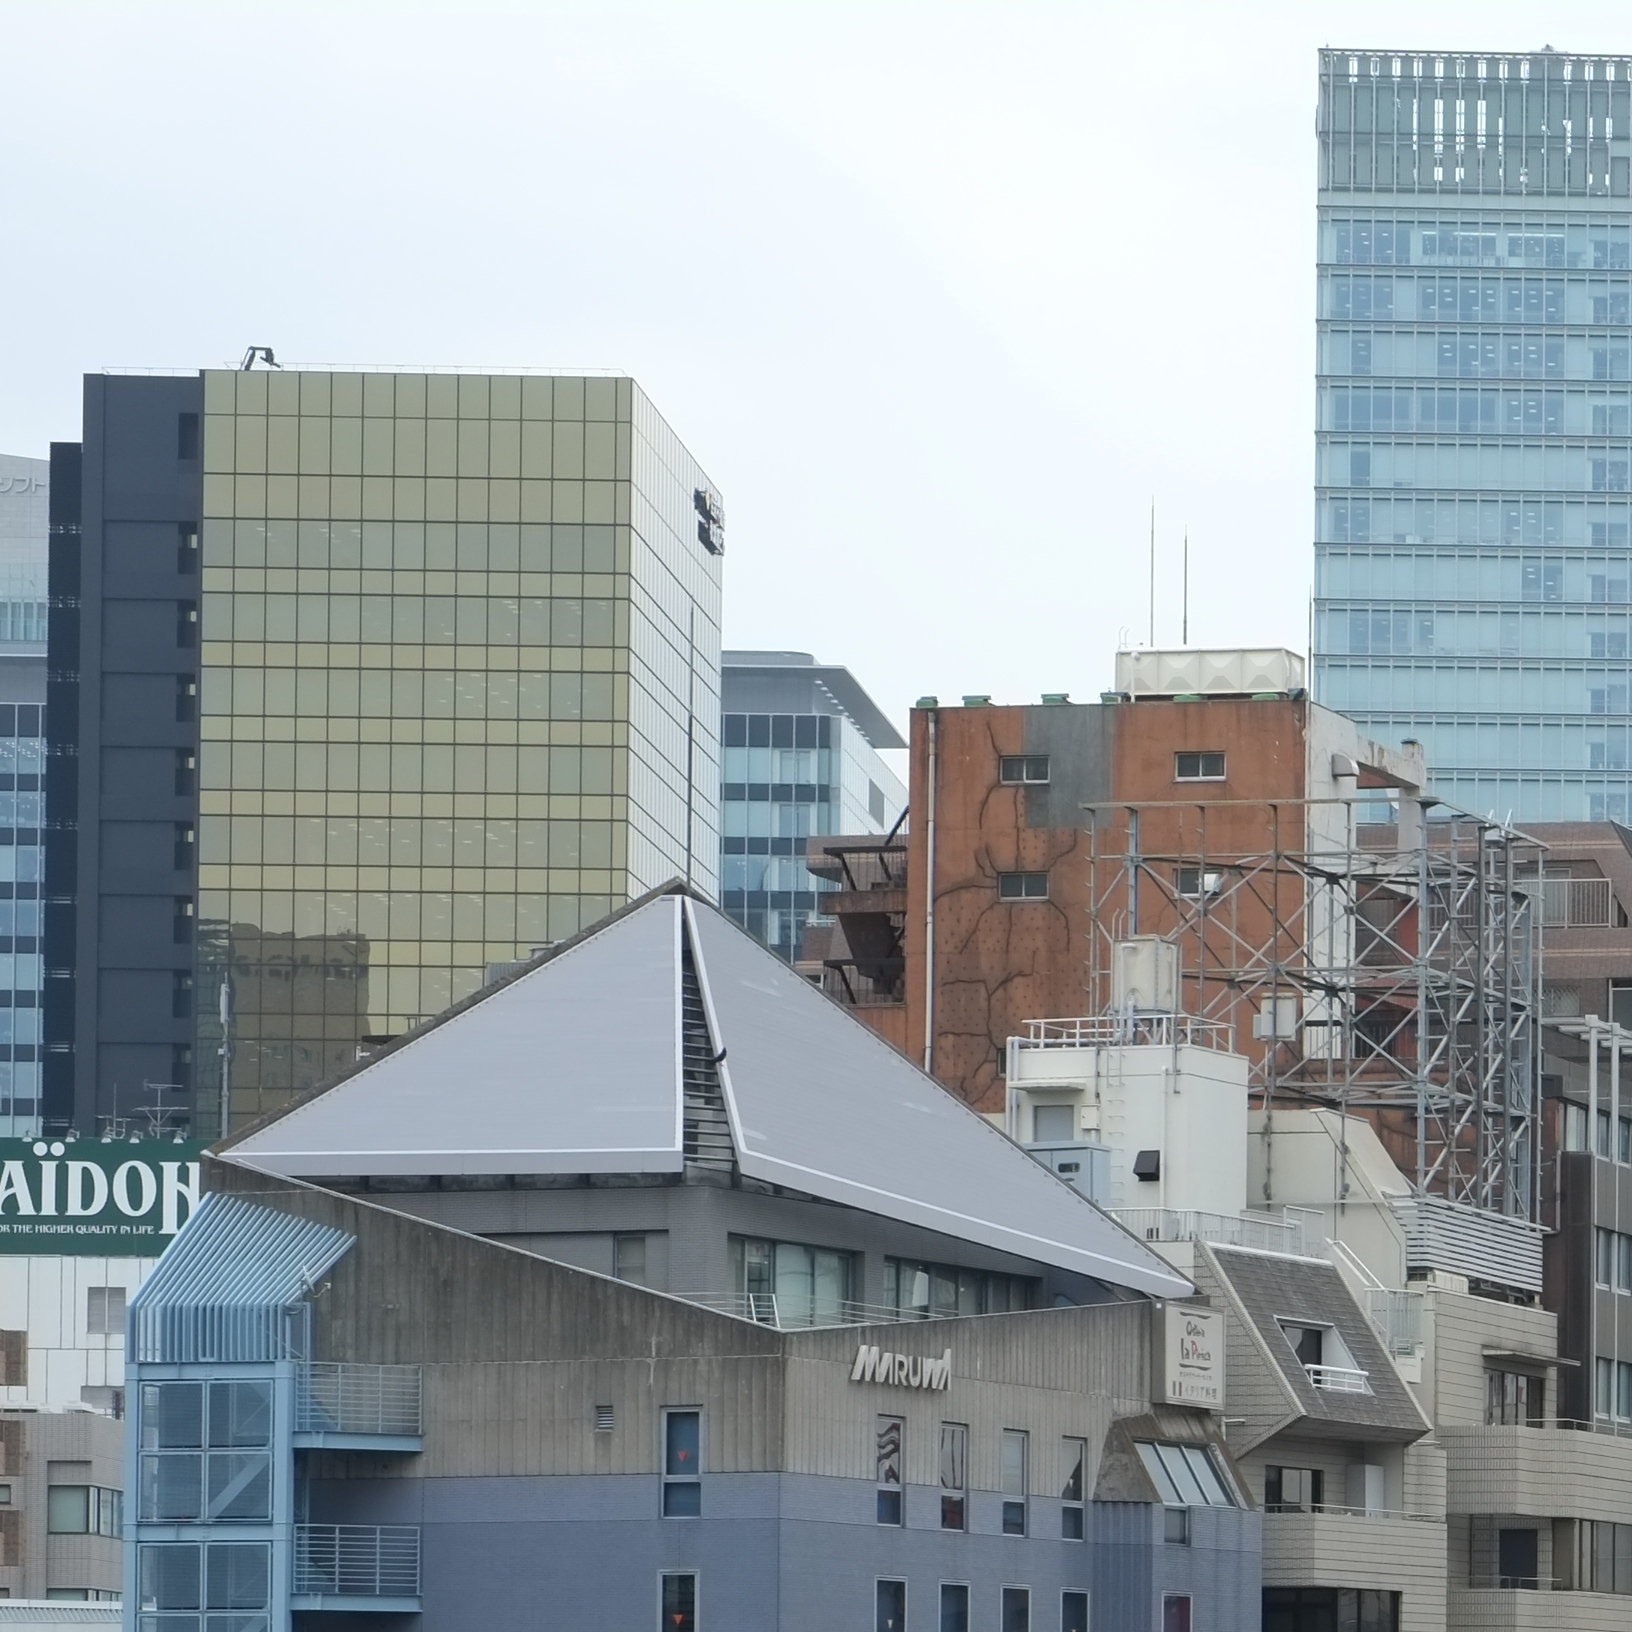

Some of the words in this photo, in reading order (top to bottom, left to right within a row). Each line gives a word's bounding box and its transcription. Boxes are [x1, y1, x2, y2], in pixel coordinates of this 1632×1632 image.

[12, 1224, 33, 1234] THE
[35, 1224, 74, 1234] HIGHER
[75, 1224, 118, 1235] QUALITY
[132, 1225, 155, 1235] LIFE
[850, 1344, 952, 1391] MARUWA
